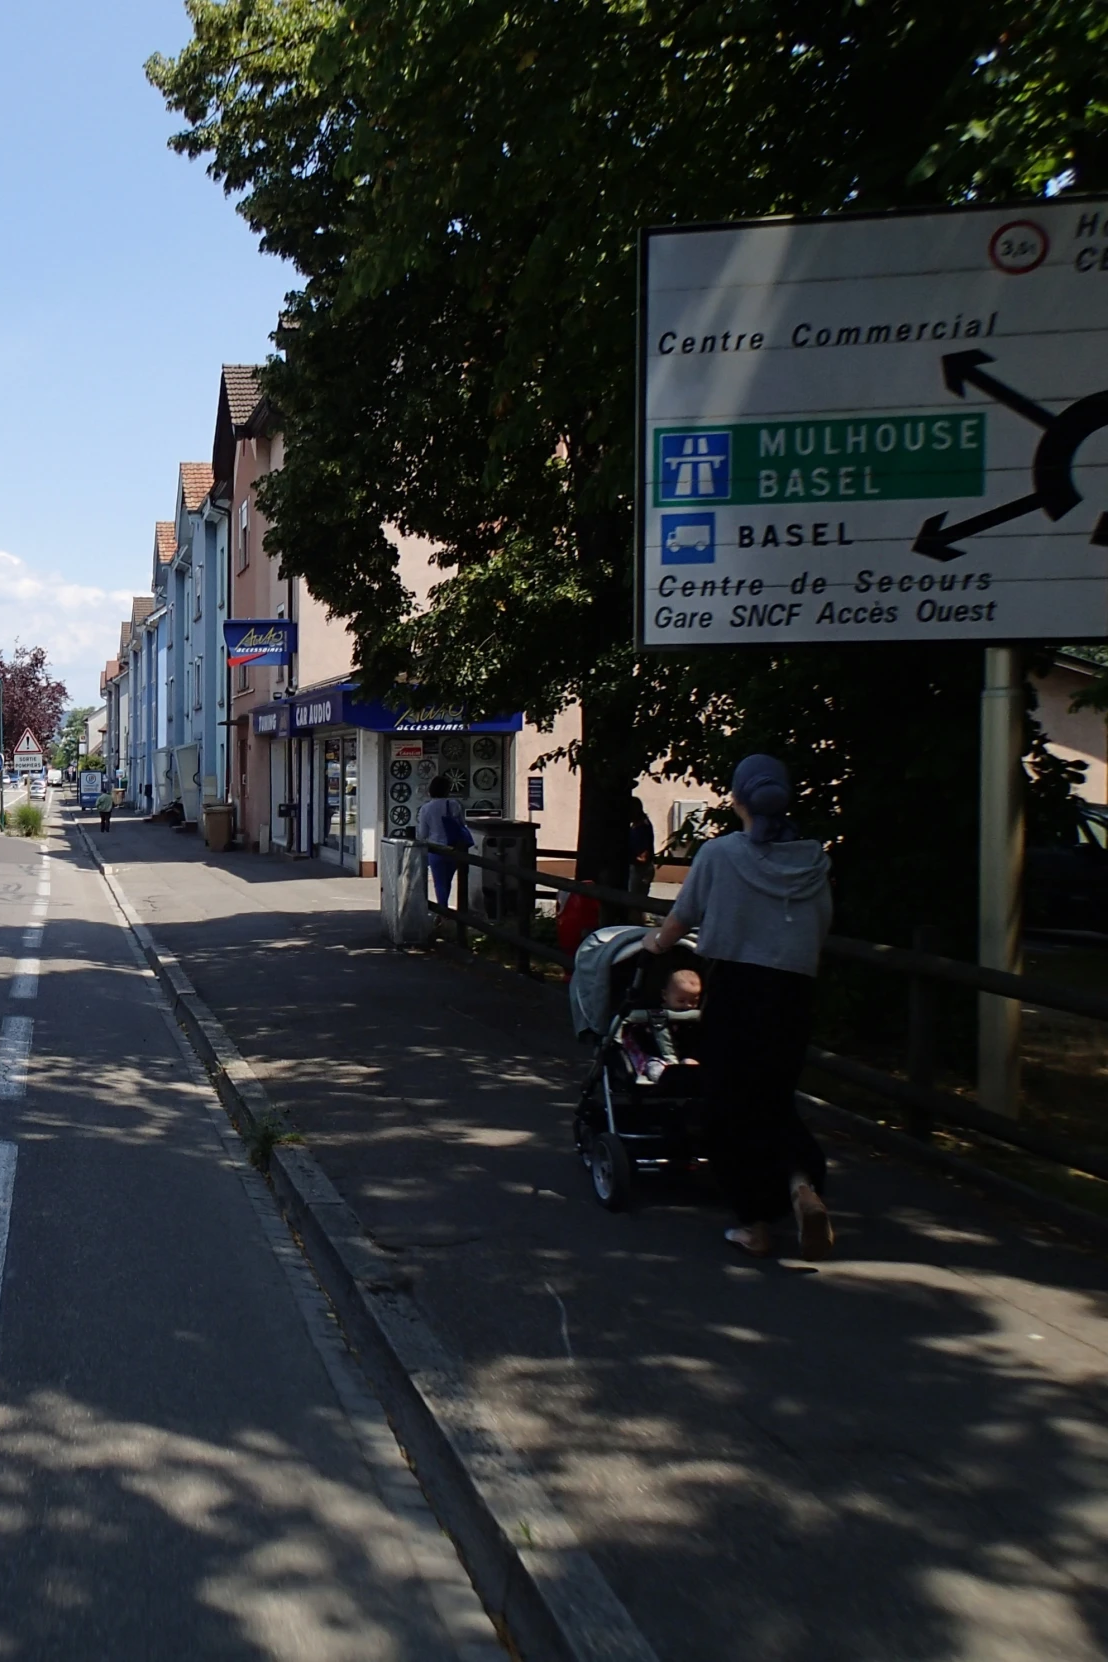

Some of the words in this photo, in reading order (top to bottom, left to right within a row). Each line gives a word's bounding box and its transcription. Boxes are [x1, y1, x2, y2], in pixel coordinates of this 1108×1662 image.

[658, 332, 764, 356] Centre
[791, 313, 997, 347] Commercial
[759, 419, 980, 458] MULHOUSE
[759, 465, 881, 498] BASEL
[738, 522, 854, 549] BASEL
[658, 574, 764, 597] Centre
[790, 571, 827, 595] de
[854, 570, 992, 594] Secours
[654, 606, 713, 629] Gare
[729, 603, 803, 628] SNCF
[816, 600, 898, 625] Accès
[916, 599, 998, 624] Ouest
[234, 626, 283, 650] Auto
[295, 706, 308, 727] CAR
[308, 700, 332, 725] AUDIO
